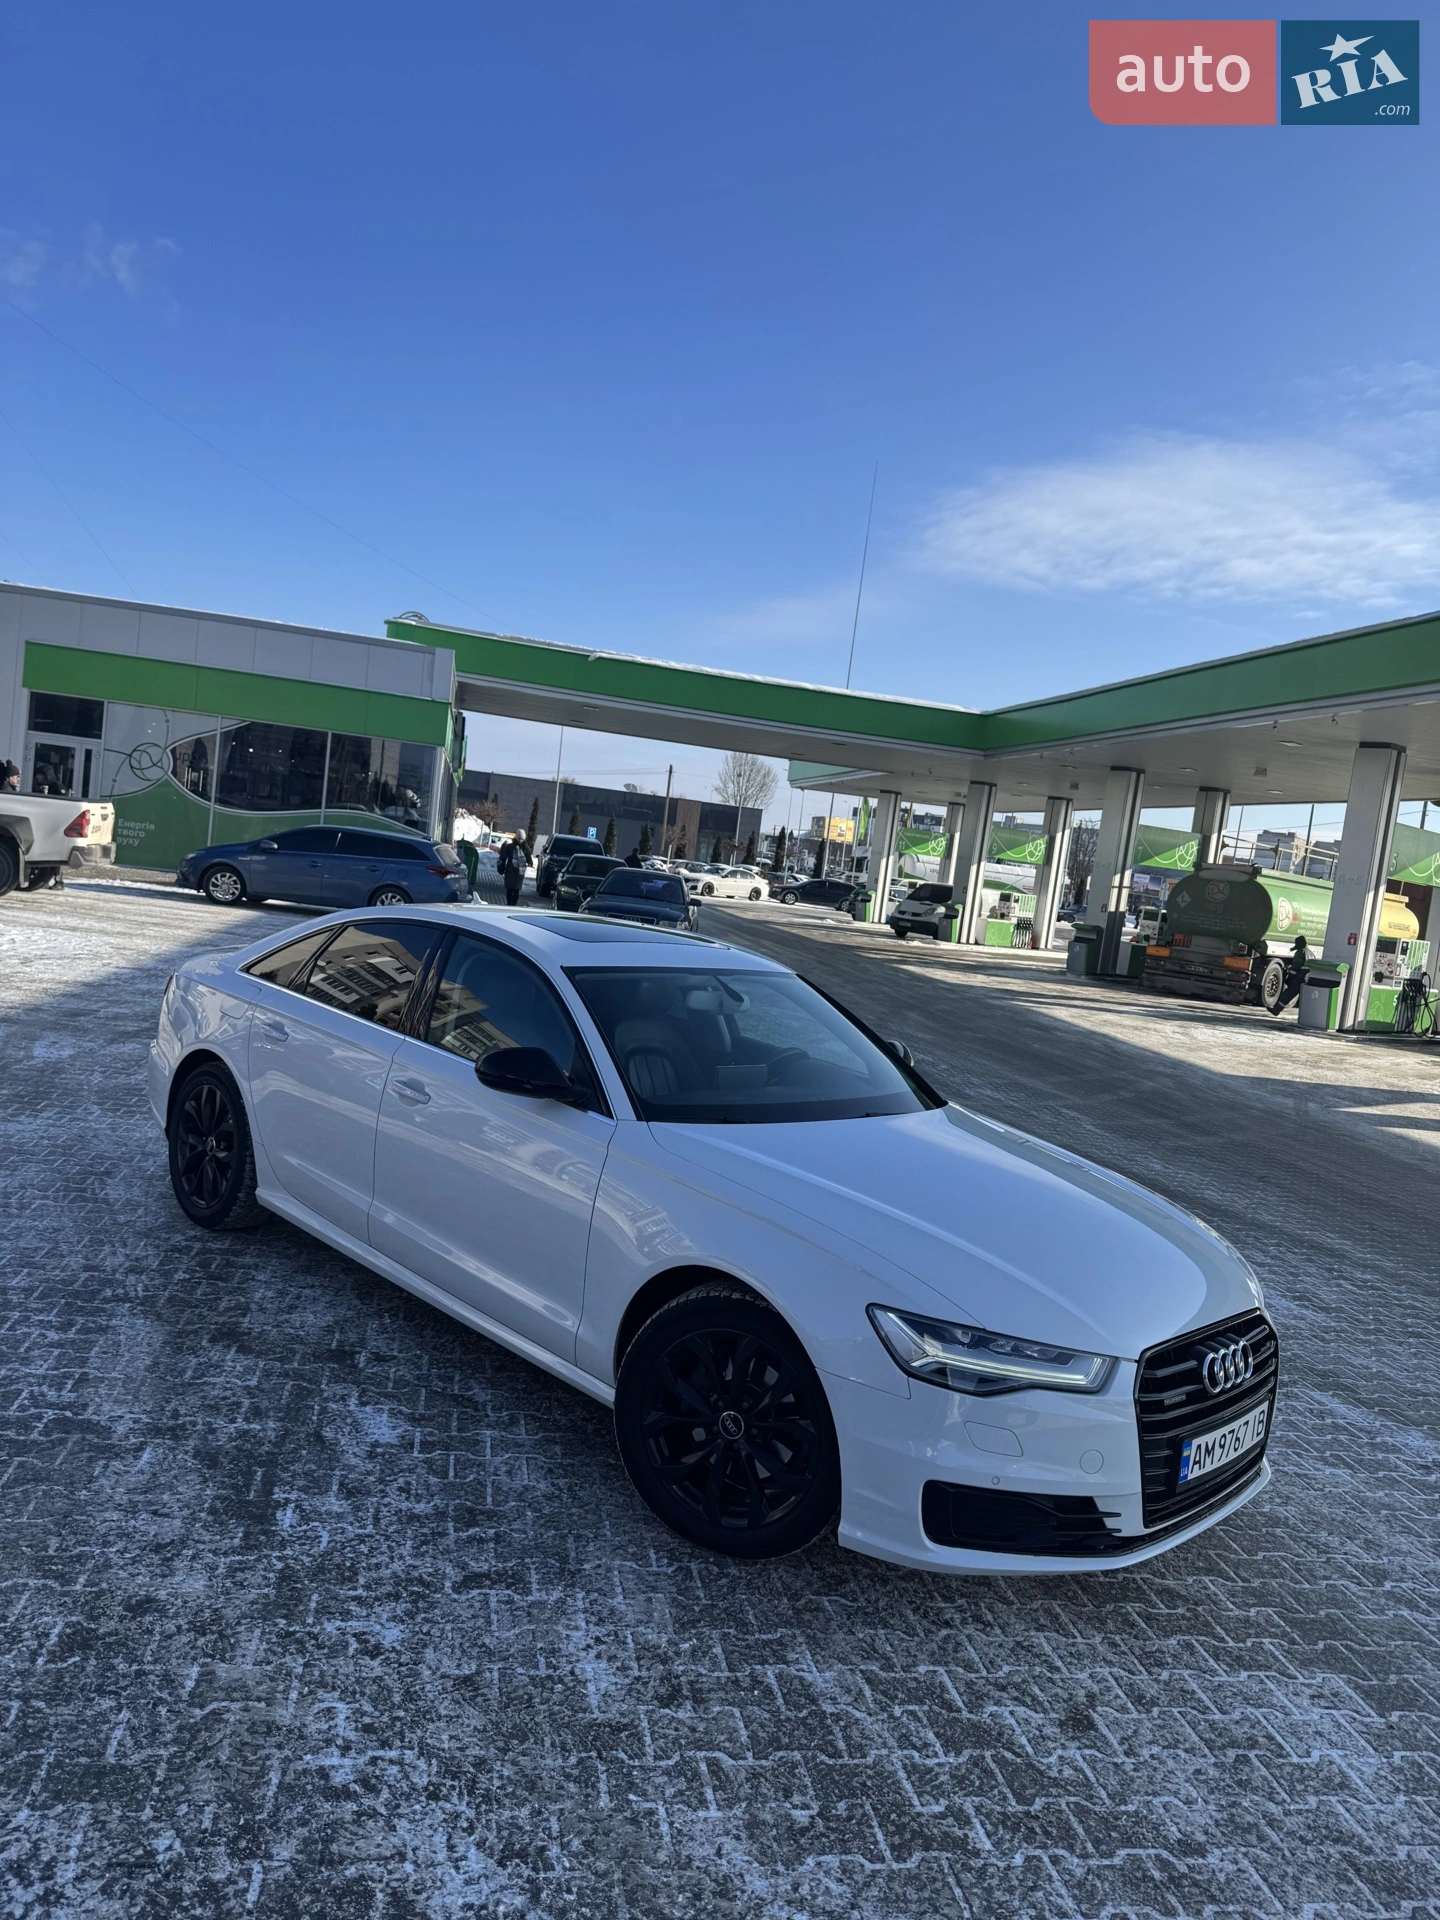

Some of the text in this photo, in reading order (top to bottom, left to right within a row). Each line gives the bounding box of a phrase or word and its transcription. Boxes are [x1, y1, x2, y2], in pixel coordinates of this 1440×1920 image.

[118, 818, 155, 830] Енергія
[117, 828, 145, 838] твого
[116, 836, 140, 847] руху
[899, 840, 906, 850] 11
[992, 842, 998, 854] 9
[1138, 846, 1144, 860] 7
[1390, 852, 1400, 872] 5
